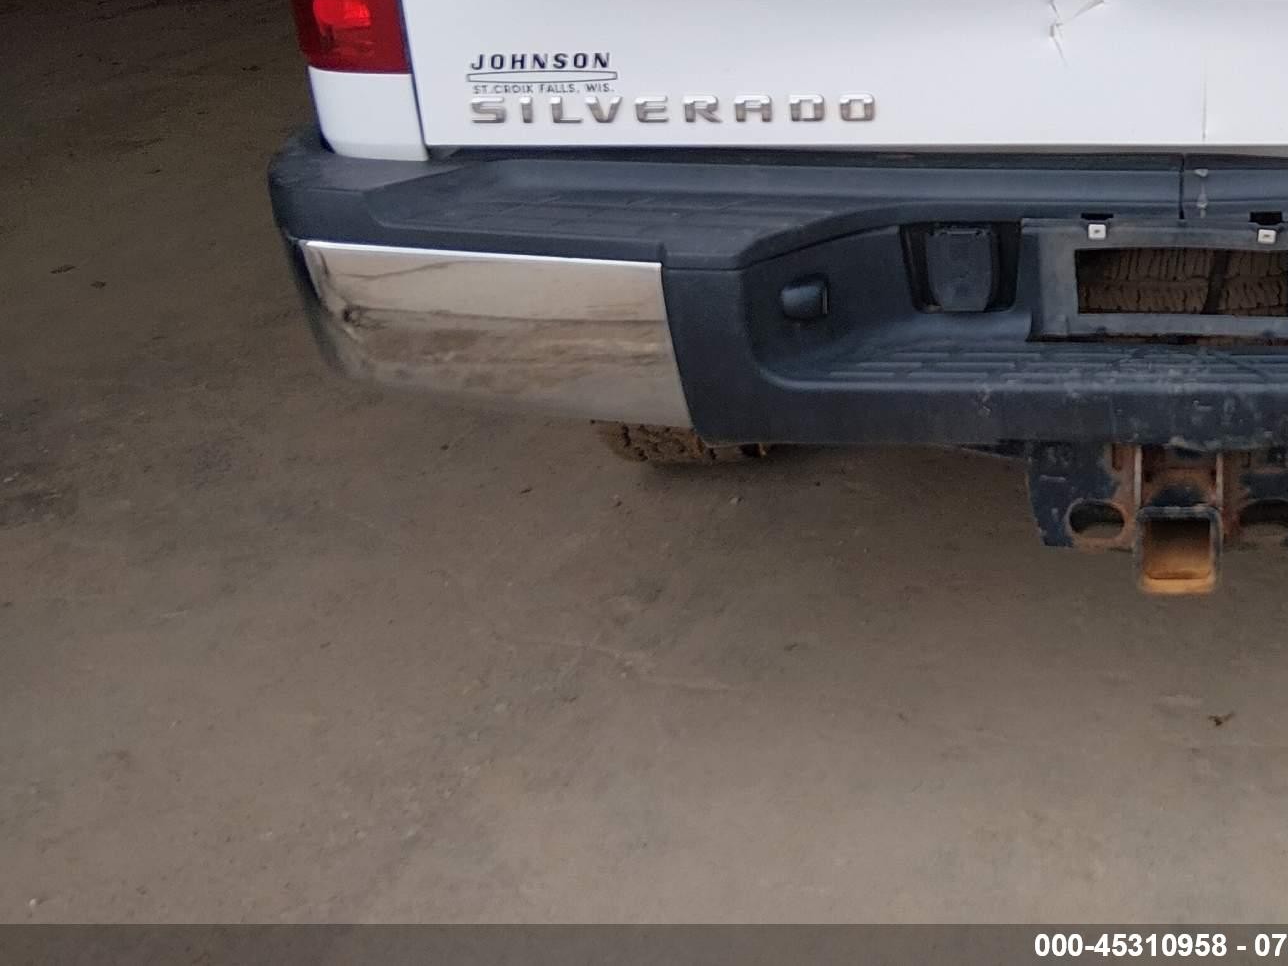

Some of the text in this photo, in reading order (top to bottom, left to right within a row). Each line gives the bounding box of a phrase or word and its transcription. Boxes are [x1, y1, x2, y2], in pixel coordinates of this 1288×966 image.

[471, 52, 610, 70] JOHNSON
[493, 84, 533, 94] CROIX
[585, 82, 615, 93] WIS.
[471, 94, 876, 124] SILVERADO
